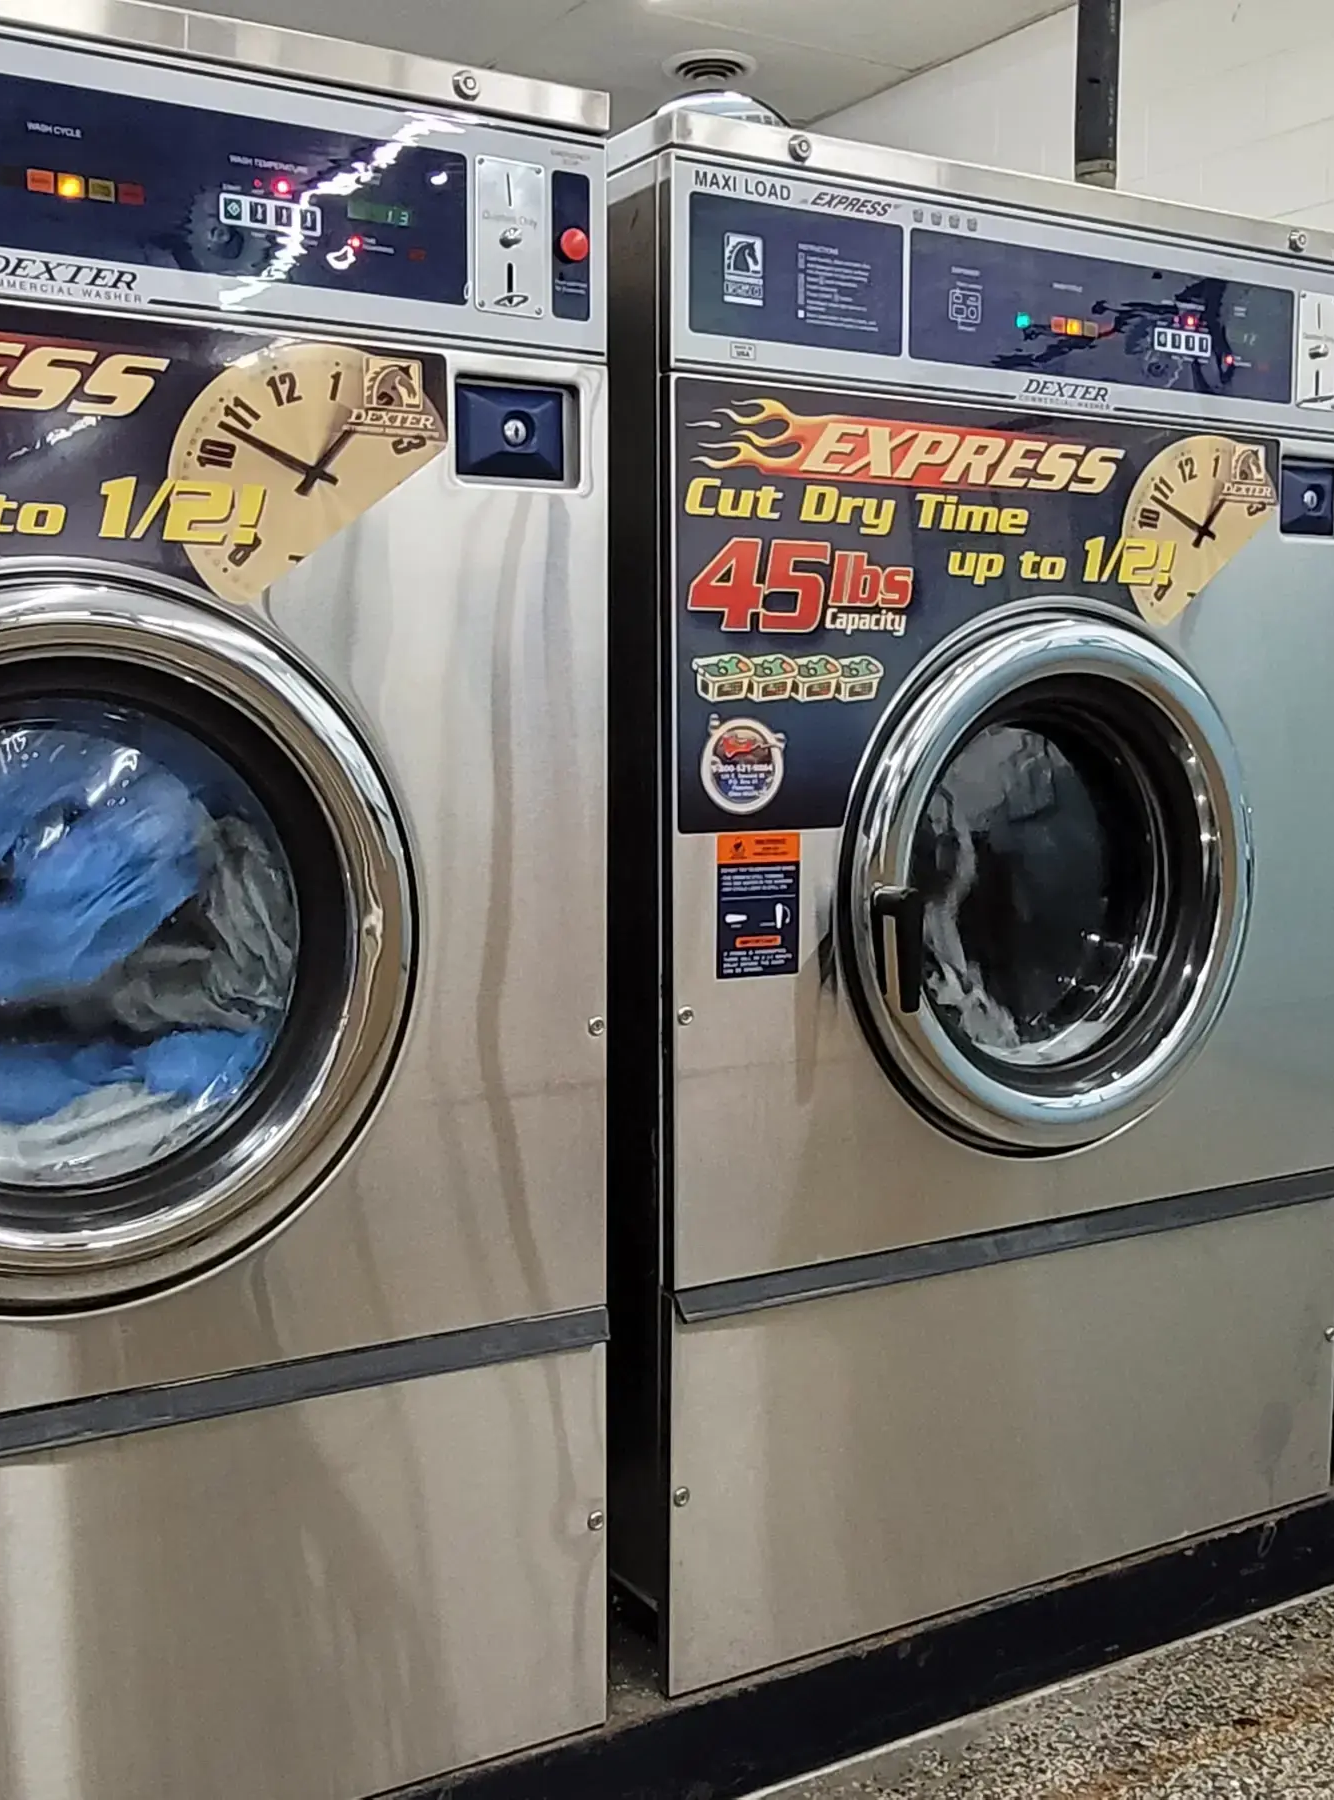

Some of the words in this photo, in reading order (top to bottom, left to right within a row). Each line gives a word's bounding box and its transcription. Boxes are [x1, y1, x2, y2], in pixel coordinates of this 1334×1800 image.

[694, 169, 737, 192] MAXI
[744, 178, 791, 201] LOAD
[810, 192, 893, 217] EXPRESS
[82, 288, 142, 304] WASHER
[266, 371, 304, 408] 12
[328, 370, 343, 402] 1
[1023, 378, 1108, 402] DEXTER
[223, 395, 262, 430] 11
[347, 407, 436, 431] DEXTER
[196, 438, 238, 469] 10
[799, 421, 1126, 494] EXPRESS
[1176, 456, 1198, 484] 12
[1153, 475, 1175, 501] 11
[1222, 482, 1273, 498] DEXTER
[99, 476, 267, 546] 1/2!
[685, 477, 782, 520] Cut
[800, 485, 896, 538] Dry
[916, 493, 1029, 535] Time
[1137, 507, 1161, 530] 10
[947, 551, 1002, 586] up
[1018, 550, 1067, 581] to
[1082, 536, 1177, 587] 1/2!
[685, 537, 831, 634] 45
[828, 548, 915, 610] lbs
[824, 607, 906, 637] Capacity
